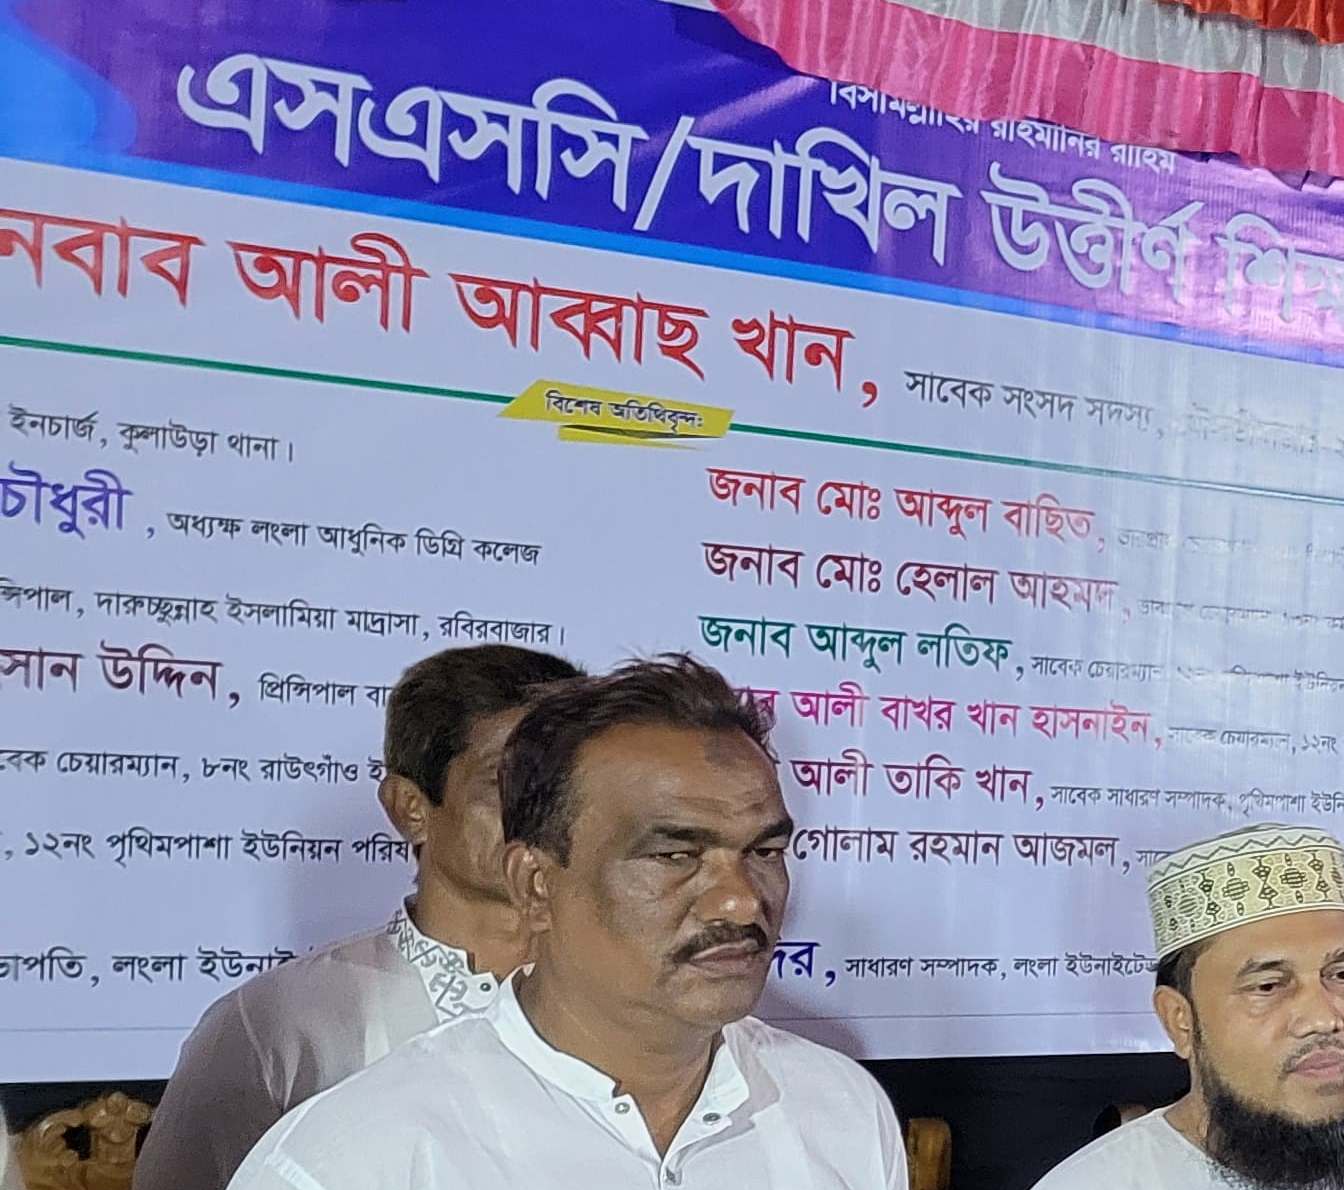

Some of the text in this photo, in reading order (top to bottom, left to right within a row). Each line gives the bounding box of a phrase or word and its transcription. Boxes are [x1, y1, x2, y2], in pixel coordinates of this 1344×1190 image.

[176, 54, 962, 267] এসএসসি/দাখিল
[981, 162, 1204, 305] উত্তীর্ণ
[225, 231, 430, 333] আলী
[448, 271, 708, 382] আব্বাছ
[731, 313, 880, 408] খান,
[904, 371, 994, 408] সাবেক
[1001, 385, 1077, 421] সংসদ
[9, 403, 107, 449] ইনচার্জ,
[117, 418, 217, 458] কুলাউড়া
[708, 468, 806, 514] জনাব
[818, 480, 881, 520] মোঃ
[895, 488, 992, 538] আব্দুল
[167, 512, 240, 541] অধ্যক্ষ
[251, 519, 307, 547] লংলা
[319, 523, 406, 556] আধুনিক
[415, 528, 464, 560] ডিগ্রি
[473, 540, 542, 566] কলেজ
[703, 542, 806, 588] জনাব
[817, 553, 881, 593] মোঃ
[897, 559, 1000, 602] হেলাল
[225, 594, 335, 632] ইসলামিয়া
[347, 608, 429, 641] মাদ্রাসা,
[97, 640, 241, 708] উদ্দিন,
[258, 670, 356, 706] প্রিন্সিপাল
[698, 615, 798, 658] জনাব
[805, 623, 907, 672] আব্দুল
[918, 623, 1025, 680] লতিফ,
[1030, 656, 1082, 677] সাবেক
[790, 681, 870, 728] আলী
[879, 696, 957, 733] বাখর
[968, 703, 1022, 737] খান
[1029, 699, 1162, 750] হাসনাইন,
[57, 750, 190, 783] চেয়ারম্যান,
[202, 757, 251, 781] ৮নং
[259, 750, 360, 784] রাউৎগাঁও
[790, 748, 874, 797] আলী
[884, 753, 965, 800] তাকি
[976, 765, 1044, 811] খান,
[1050, 786, 1102, 806] সাবেক
[1107, 788, 1160, 807] সাধারণ
[26, 827, 414, 870] ১২নং পৃথিমপাশা ইউনিয়ন পরিষ
[792, 825, 900, 864] গোলাম
[909, 830, 1005, 865] রহমান
[1013, 831, 1130, 873] আজমল,
[112, 955, 188, 983] লংলা
[846, 957, 913, 979] সাধারণ
[919, 957, 1006, 981] সম্পাদক,
[1012, 957, 1058, 979] লংলা
